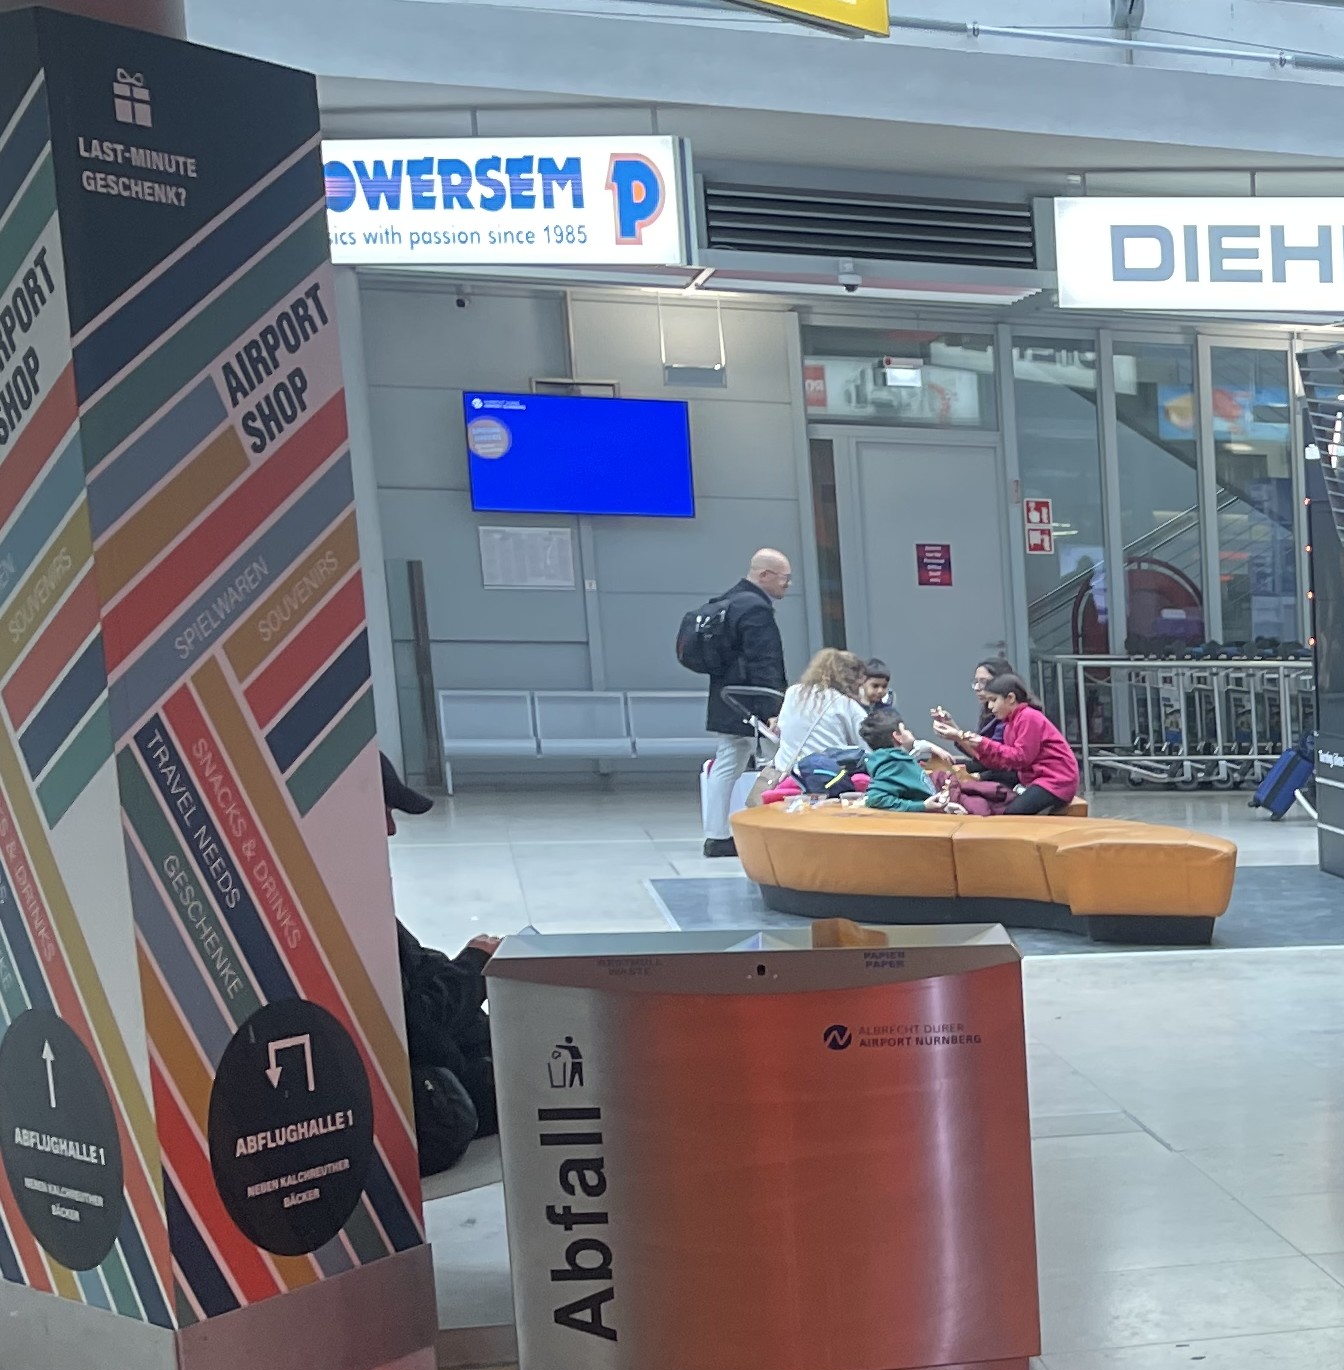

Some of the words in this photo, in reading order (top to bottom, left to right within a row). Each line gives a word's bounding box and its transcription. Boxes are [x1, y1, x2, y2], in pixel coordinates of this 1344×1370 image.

[79, 137, 197, 179] LAST-MINUTE
[81, 170, 187, 207] GESCHENK?
[324, 155, 585, 213] OWERSEM
[362, 225, 402, 244] with
[409, 226, 481, 250] passion
[489, 225, 536, 245] since
[543, 225, 588, 245] 1985
[221, 282, 330, 409] AIRPORT
[240, 366, 309, 455] SHOP
[174, 554, 271, 660] SPIELWAREN
[257, 550, 340, 643] SOUVENIRS
[146, 728, 196, 828] TRAVEL
[193, 824, 241, 910] NEEDS
[191, 737, 247, 839] SNACKS
[241, 839, 257, 861] &
[252, 859, 302, 951] DRINKS
[15, 865, 55, 962] DRINKS
[162, 853, 245, 996] GESCHENKE
[859, 1024, 920, 1036] ALBRECHT
[859, 1036, 912, 1048] AIRPORT
[15, 1127, 98, 1164] ABFLUGHALLE
[99, 1147, 106, 1166] 1
[235, 1111, 345, 1158] ABFLUGHALLE
[346, 1109, 354, 1127] 1
[538, 1107, 619, 1342] Abfall
